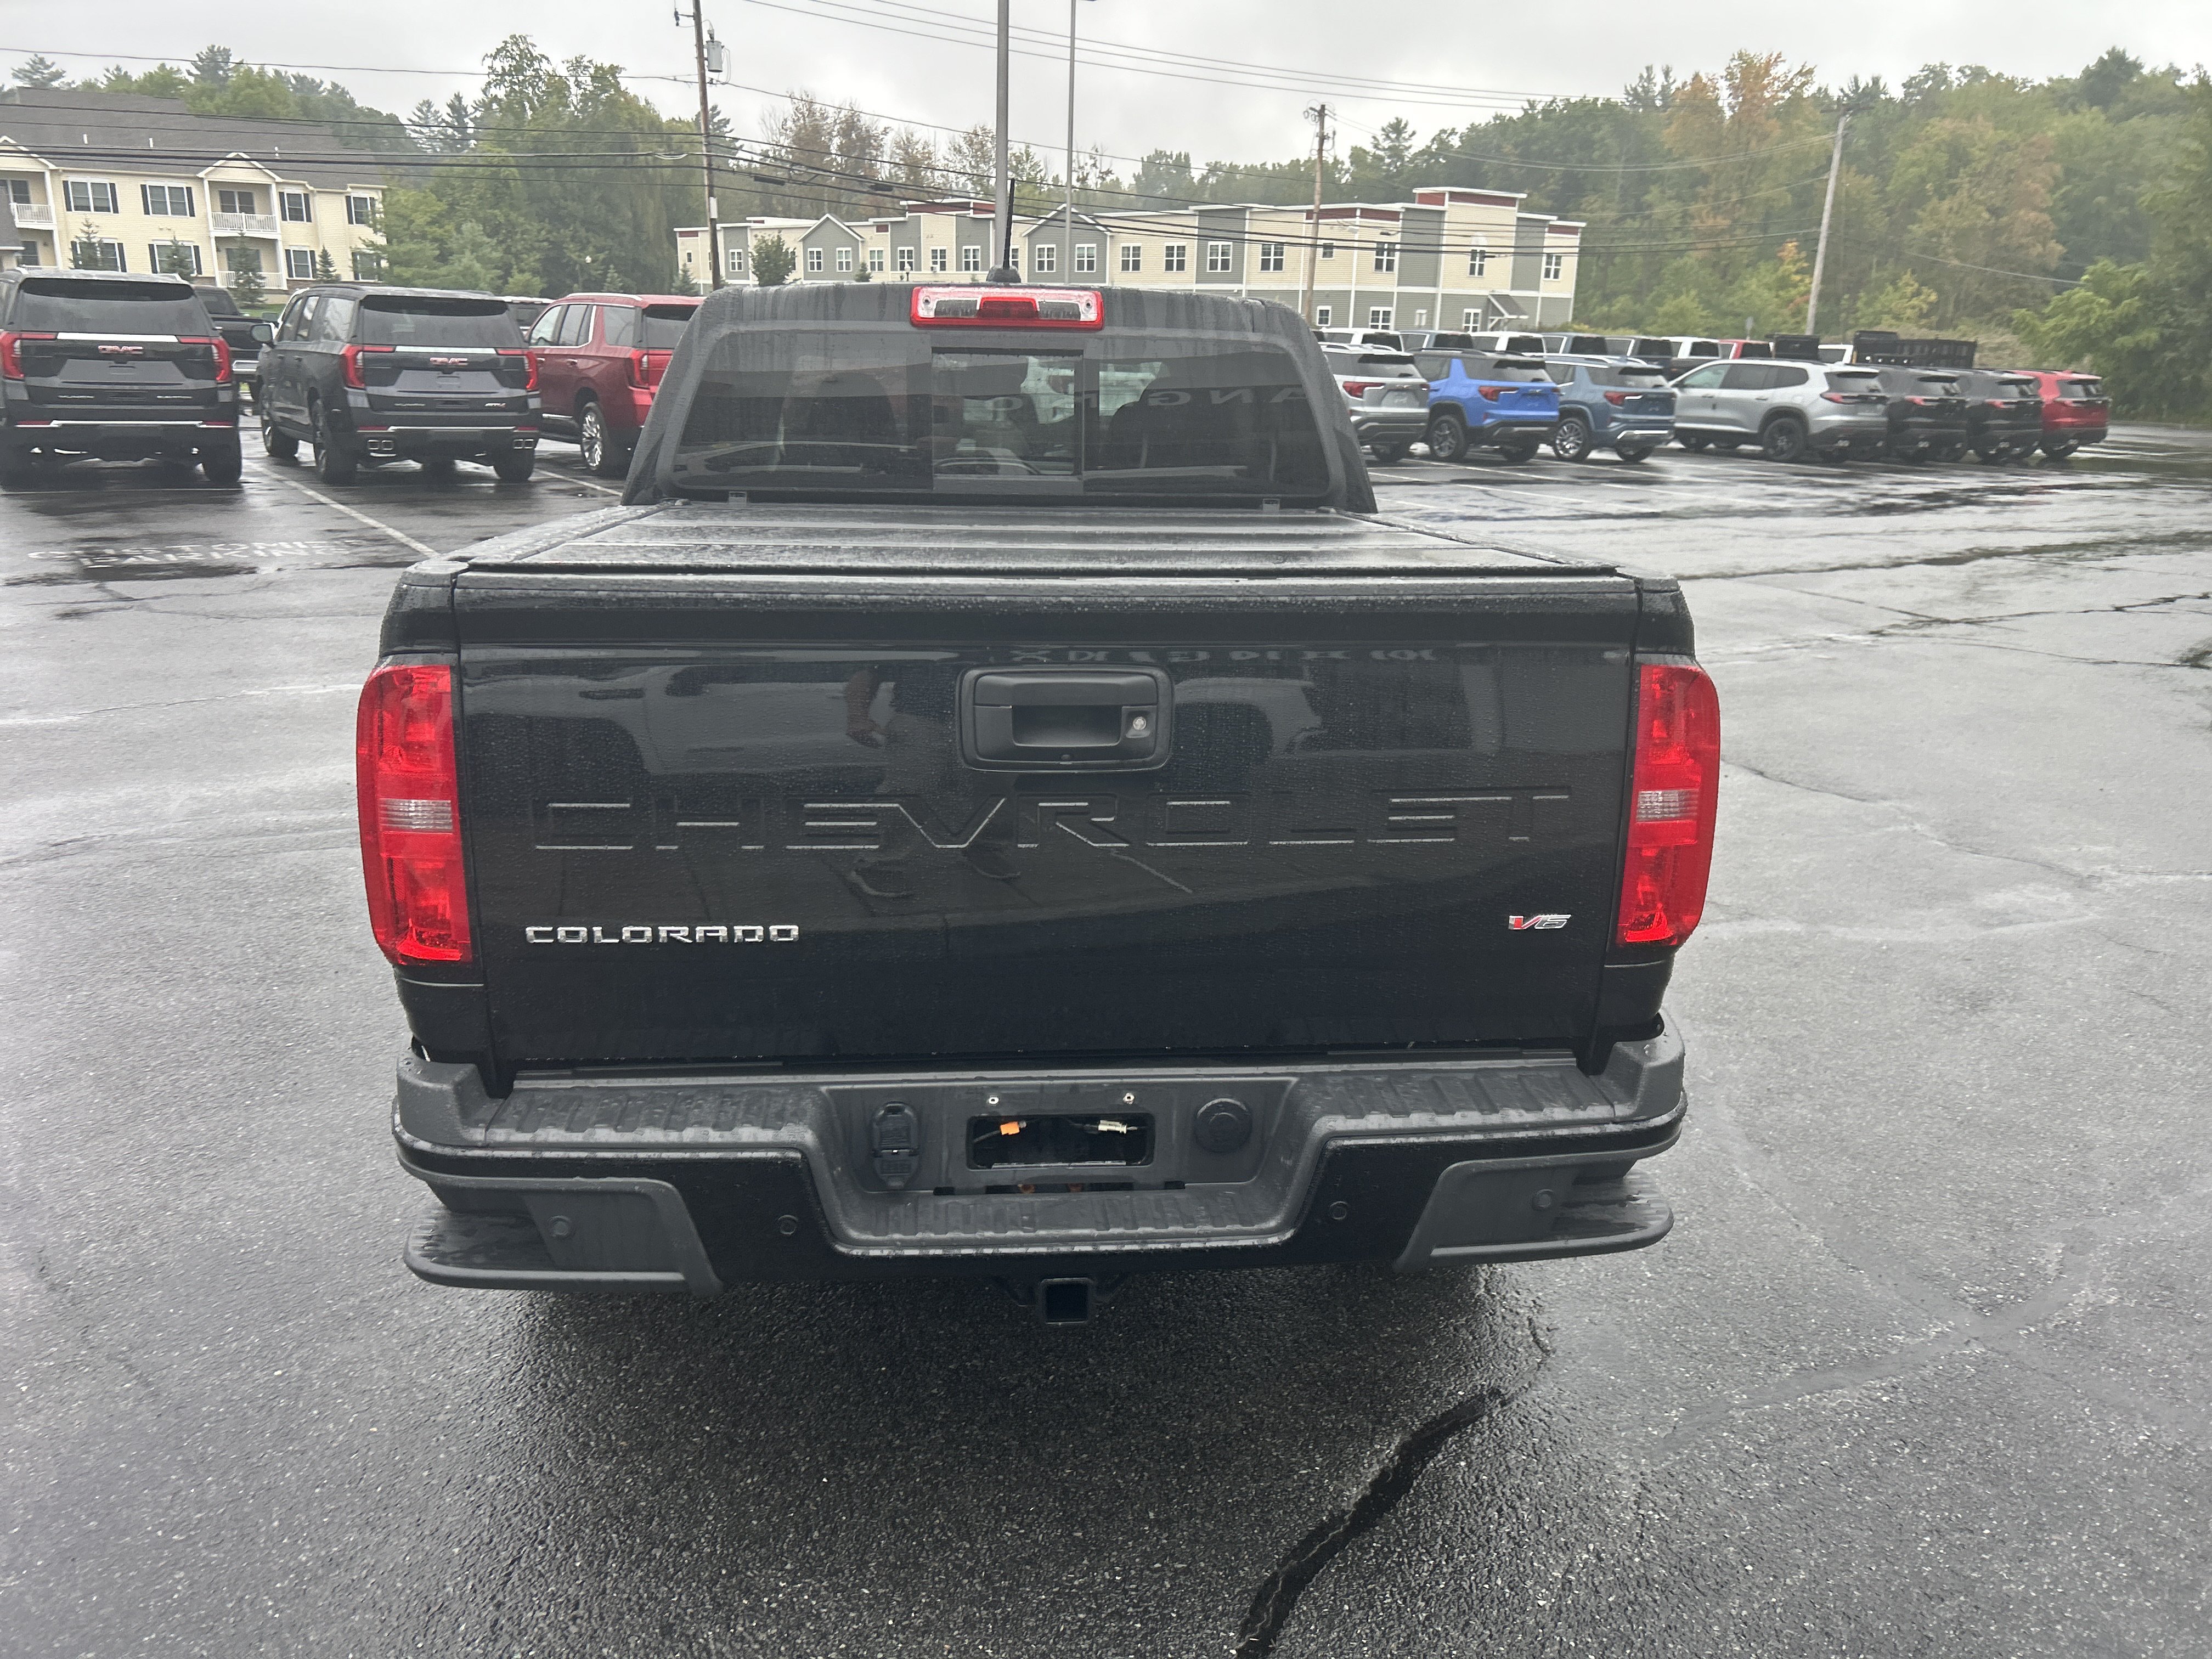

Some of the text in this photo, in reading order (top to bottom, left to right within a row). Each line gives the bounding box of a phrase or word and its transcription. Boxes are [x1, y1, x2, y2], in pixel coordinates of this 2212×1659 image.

[81, 549, 350, 565] PARKING
[530, 788, 1572, 850] CHEVROLET
[1508, 914, 1572, 930] V6
[525, 925, 800, 944] COLORADO
